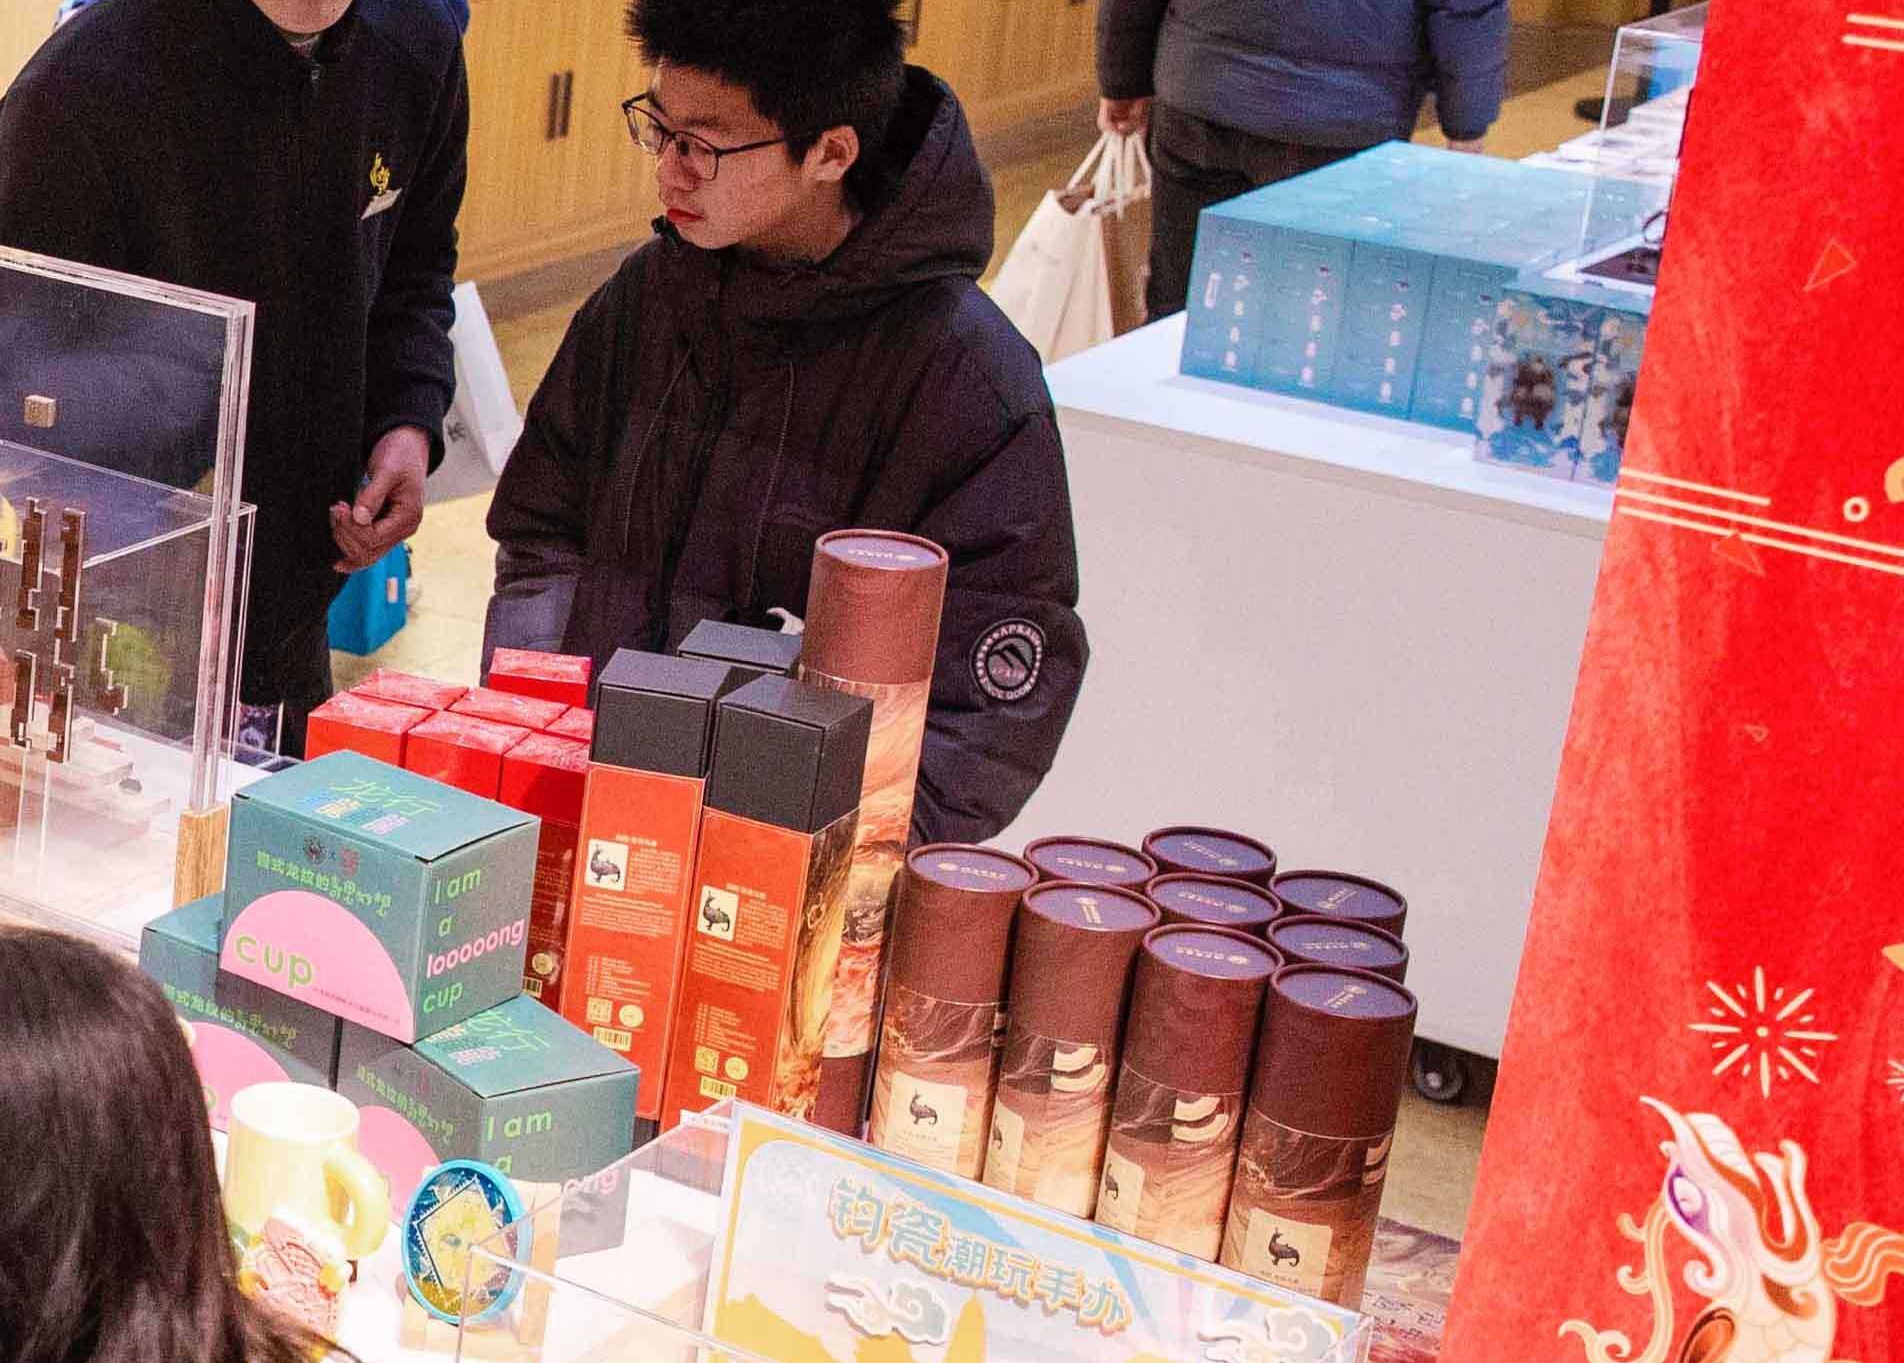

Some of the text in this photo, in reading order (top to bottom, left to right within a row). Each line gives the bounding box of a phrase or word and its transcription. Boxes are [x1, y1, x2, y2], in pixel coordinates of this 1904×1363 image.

[447, 868, 481, 898] am
[438, 916, 453, 937] a
[235, 935, 314, 989] cup
[423, 981, 464, 1014] cup
[503, 1110, 553, 1138] am
